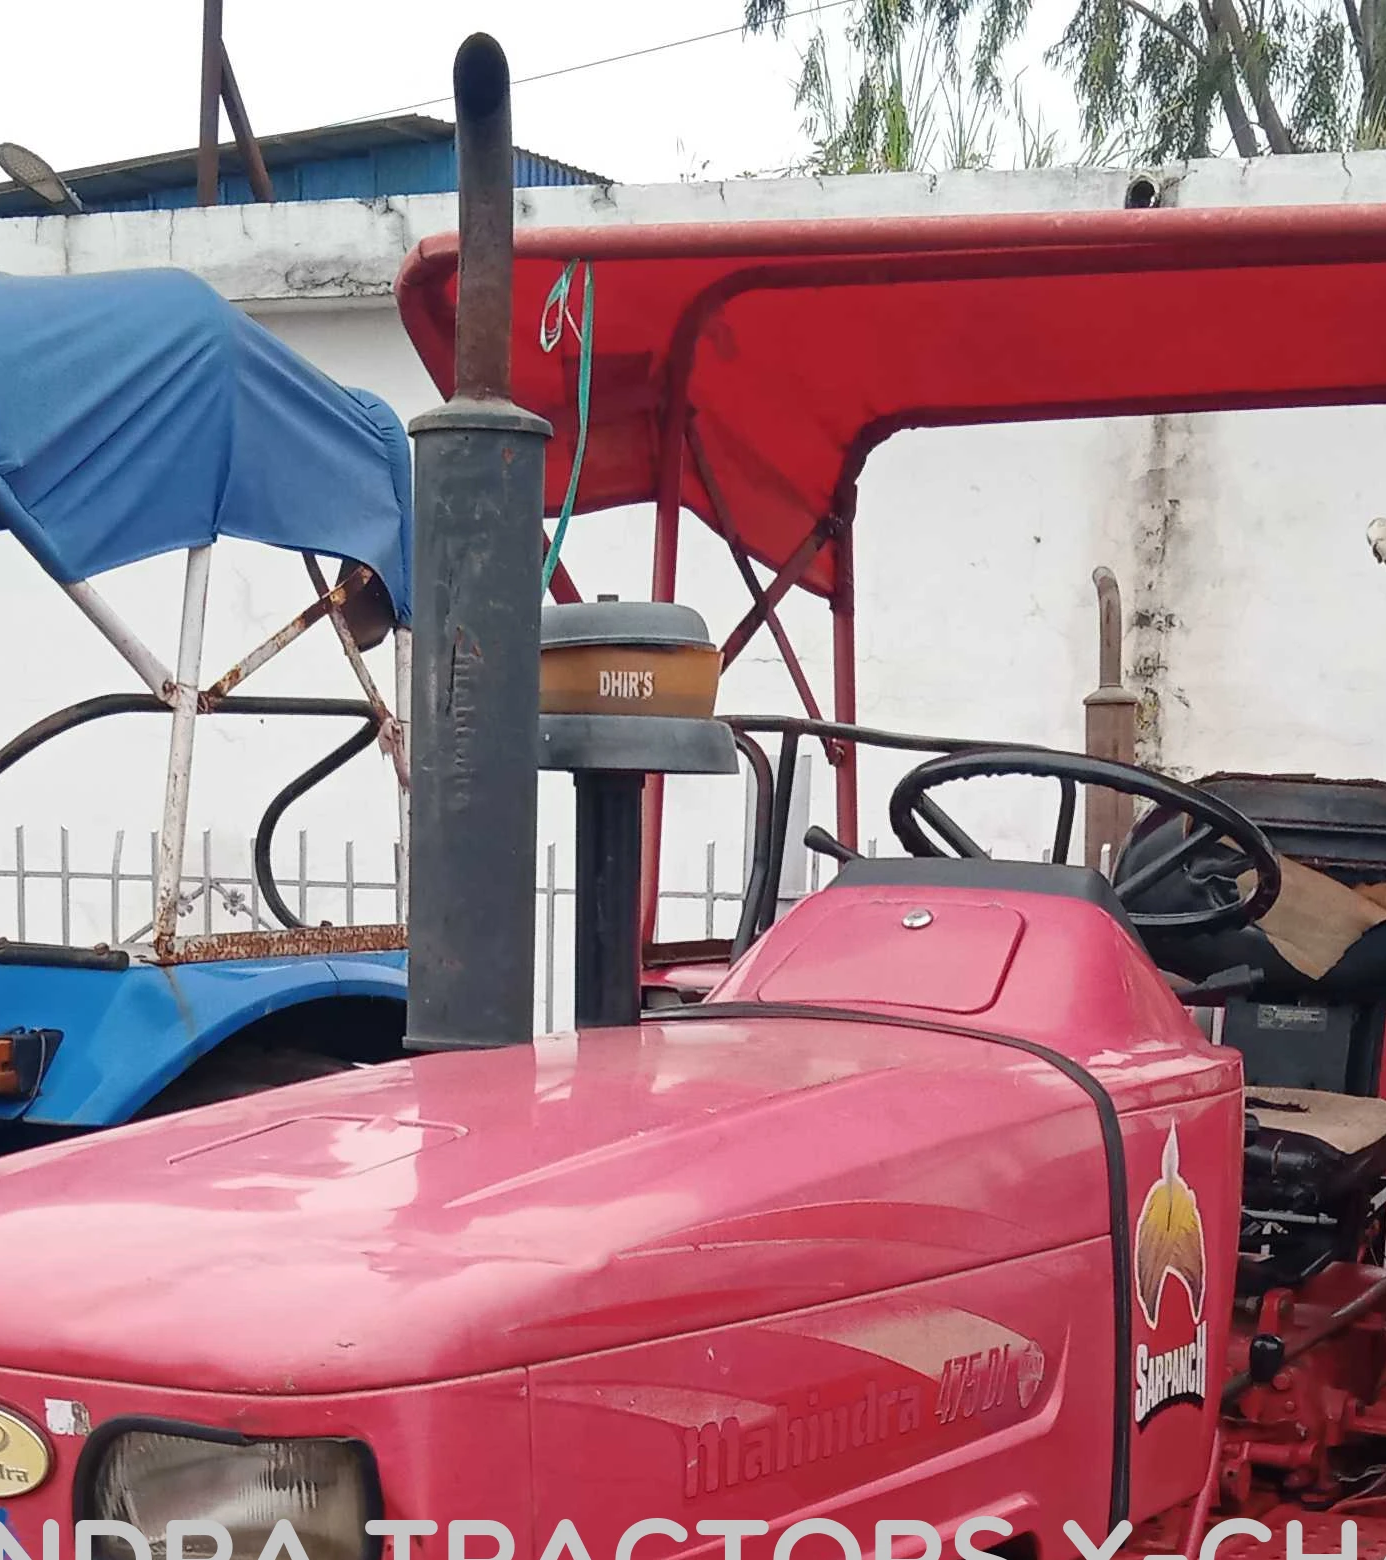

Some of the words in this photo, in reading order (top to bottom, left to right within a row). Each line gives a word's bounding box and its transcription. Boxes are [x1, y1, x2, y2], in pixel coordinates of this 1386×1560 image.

[599, 671, 654, 698] DHIR'S
[934, 1351, 982, 1425] 475
[980, 1343, 1011, 1412] DI
[1135, 1320, 1207, 1422] SARPANCH
